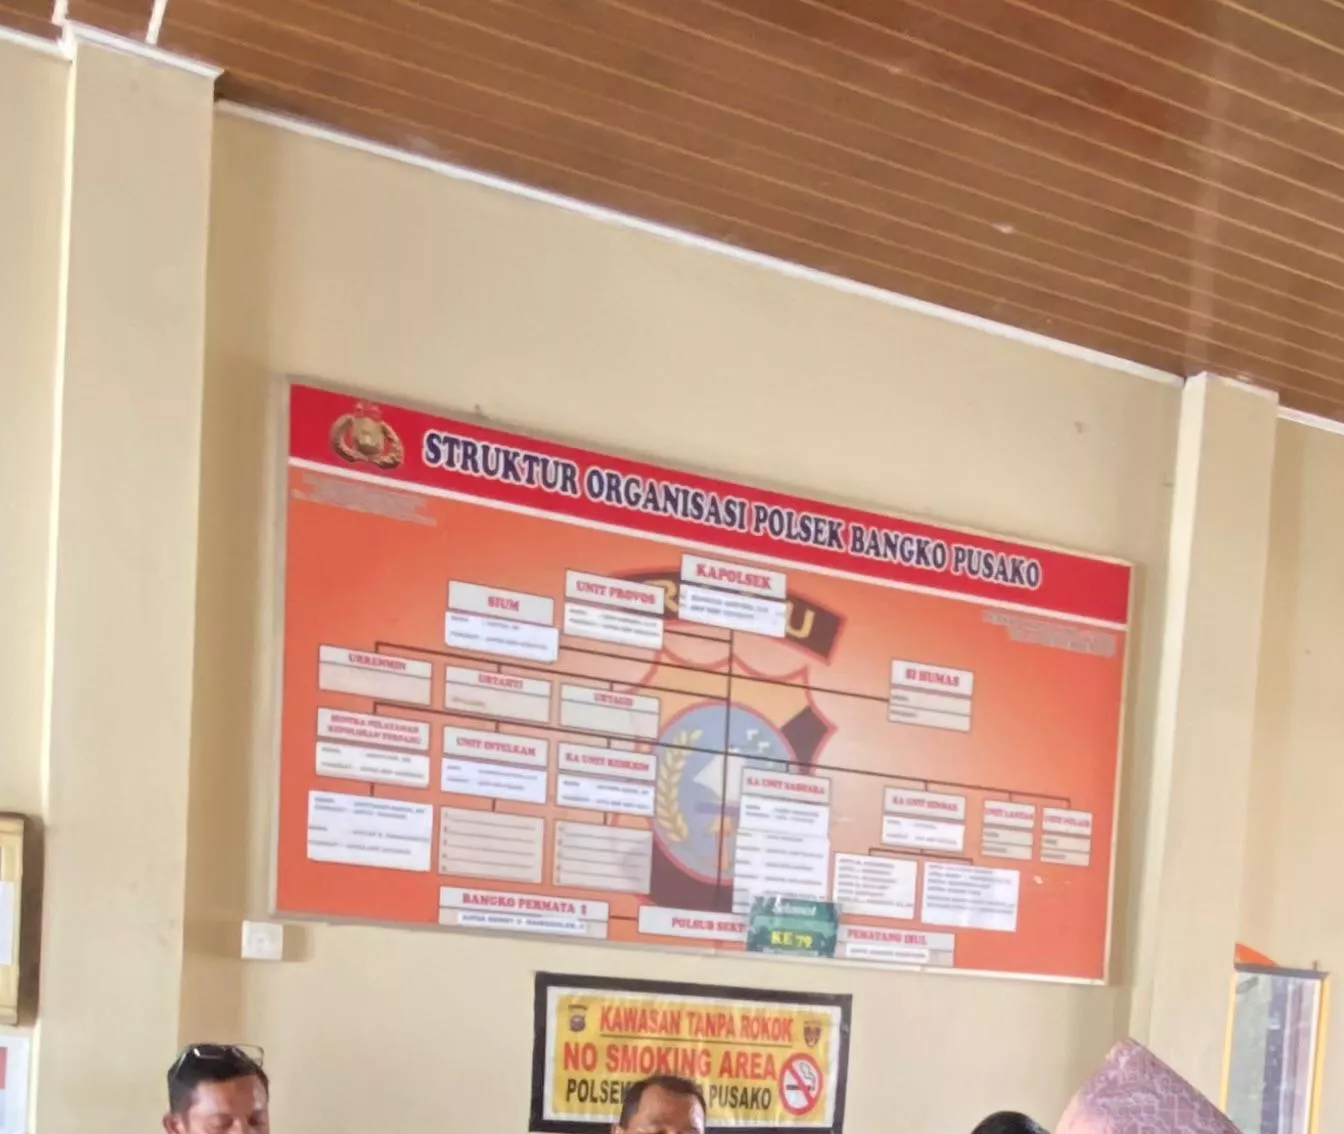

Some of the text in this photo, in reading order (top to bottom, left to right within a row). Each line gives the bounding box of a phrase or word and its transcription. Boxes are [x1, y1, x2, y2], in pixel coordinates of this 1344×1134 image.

[425, 432, 1040, 588] STRUKTUR ORGANISASI POLSEK BANGKO PUSAKO
[696, 563, 771, 590] KAPOLSEK
[462, 893, 516, 908] BANGKO
[518, 898, 576, 914] PERMATA
[771, 931, 793, 946] KE
[599, 1006, 794, 1042] KAWASAN TANPA ROKOK
[563, 1042, 777, 1081] NO SMOKING AREA
[708, 1084, 772, 1110] PUSAKO
